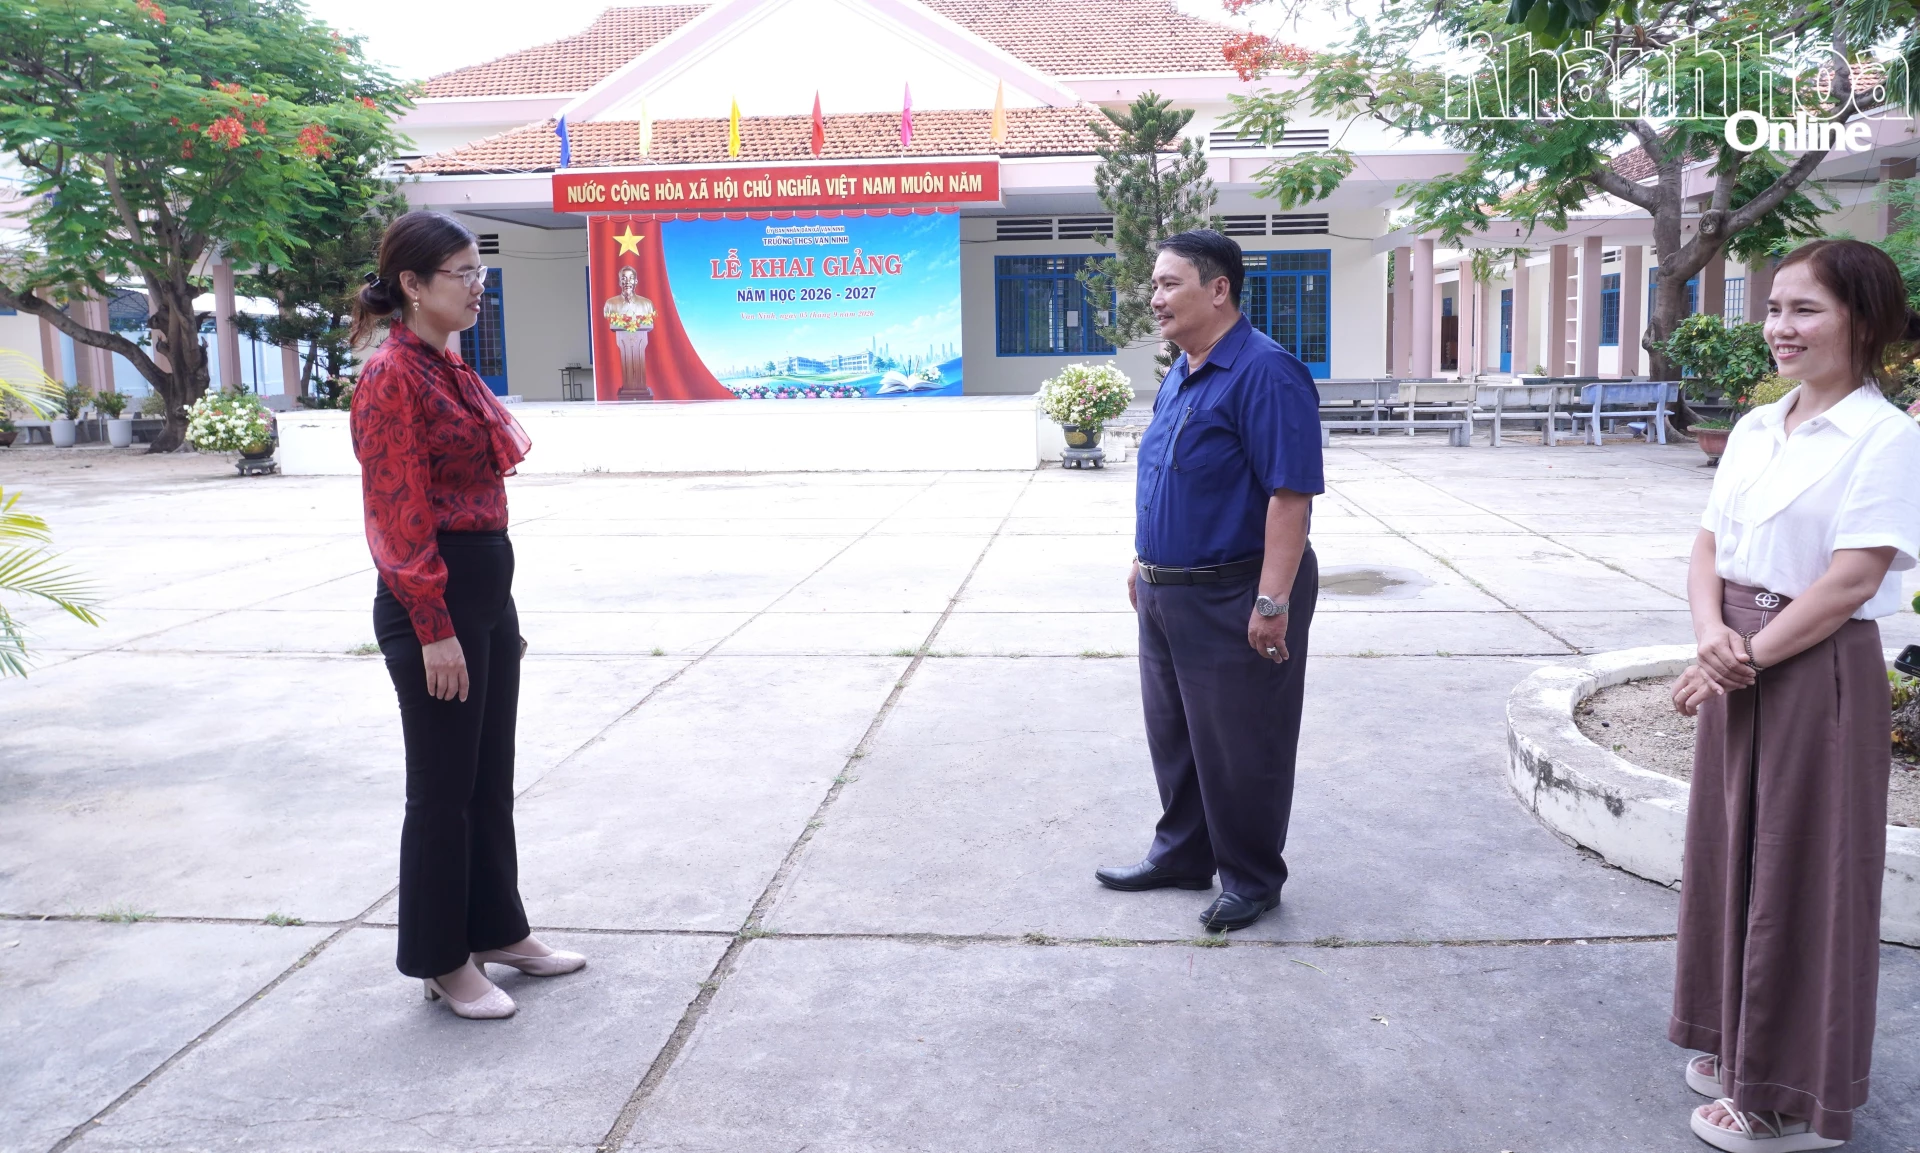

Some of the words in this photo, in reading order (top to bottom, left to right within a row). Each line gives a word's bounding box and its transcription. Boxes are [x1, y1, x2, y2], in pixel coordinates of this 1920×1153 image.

[567, 180, 605, 203] NƯỚC
[610, 180, 650, 204] CỘNG
[655, 178, 684, 200] HÒA
[689, 178, 709, 200] XÃ
[714, 176, 739, 202] HỘI
[743, 174, 772, 198] CHỦ
[777, 175, 821, 197] NGHĨA
[825, 174, 858, 198] VIỆT
[862, 177, 896, 195] NAM
[901, 172, 944, 194] MUÔN
[949, 171, 983, 193] NĂM
[794, 236, 812, 245] THCS
[814, 236, 829, 246] VẠN
[831, 236, 848, 244] NINH
[710, 248, 742, 279] LỄ
[750, 257, 815, 278] KHAI
[823, 248, 902, 276] GIẢNG
[737, 287, 765, 302] NĂM
[770, 289, 796, 303] HỌC
[800, 288, 832, 301] 2026
[844, 287, 877, 300] 2027
